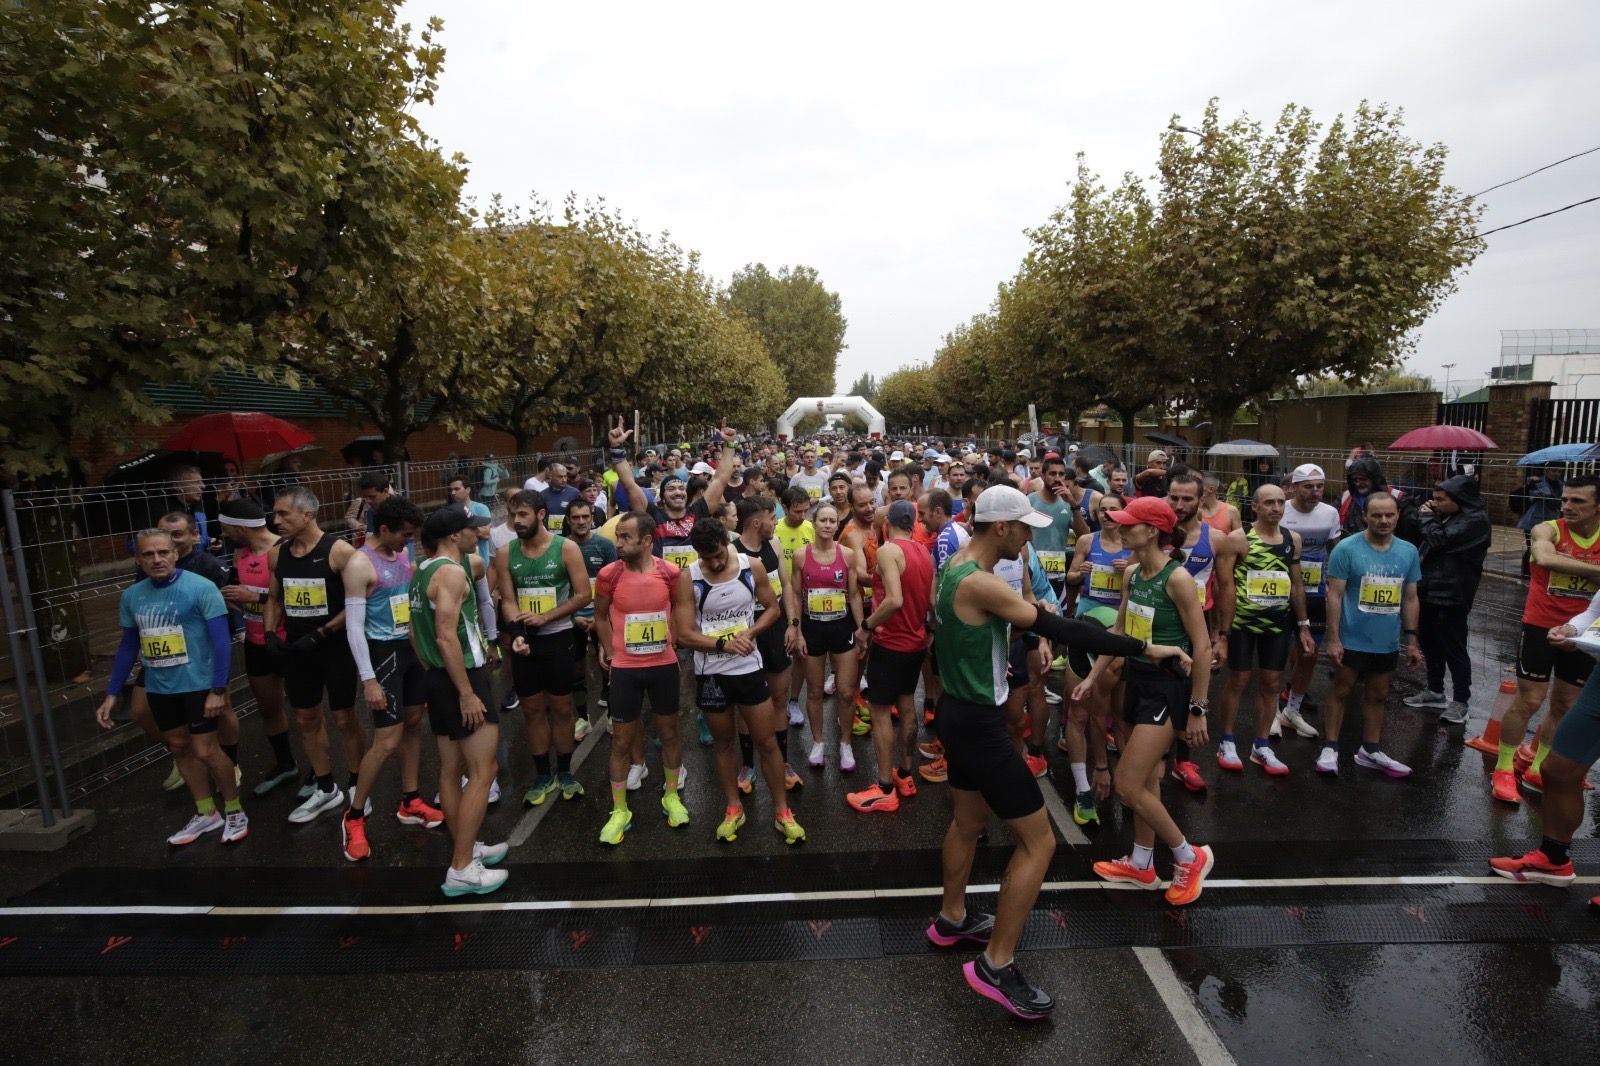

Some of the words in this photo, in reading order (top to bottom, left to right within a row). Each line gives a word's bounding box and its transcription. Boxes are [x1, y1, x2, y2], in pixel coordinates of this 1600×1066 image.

[675, 556, 688, 568] 92
[1045, 560, 1059, 571] 173
[1106, 576, 1114, 589] 11
[1261, 582, 1277, 596] 49
[296, 591, 311, 605] 46
[1373, 589, 1392, 604] 162
[529, 600, 541, 613] 111
[822, 599, 833, 612] 13
[642, 626, 654, 641] 41
[148, 640, 171, 657] 164
